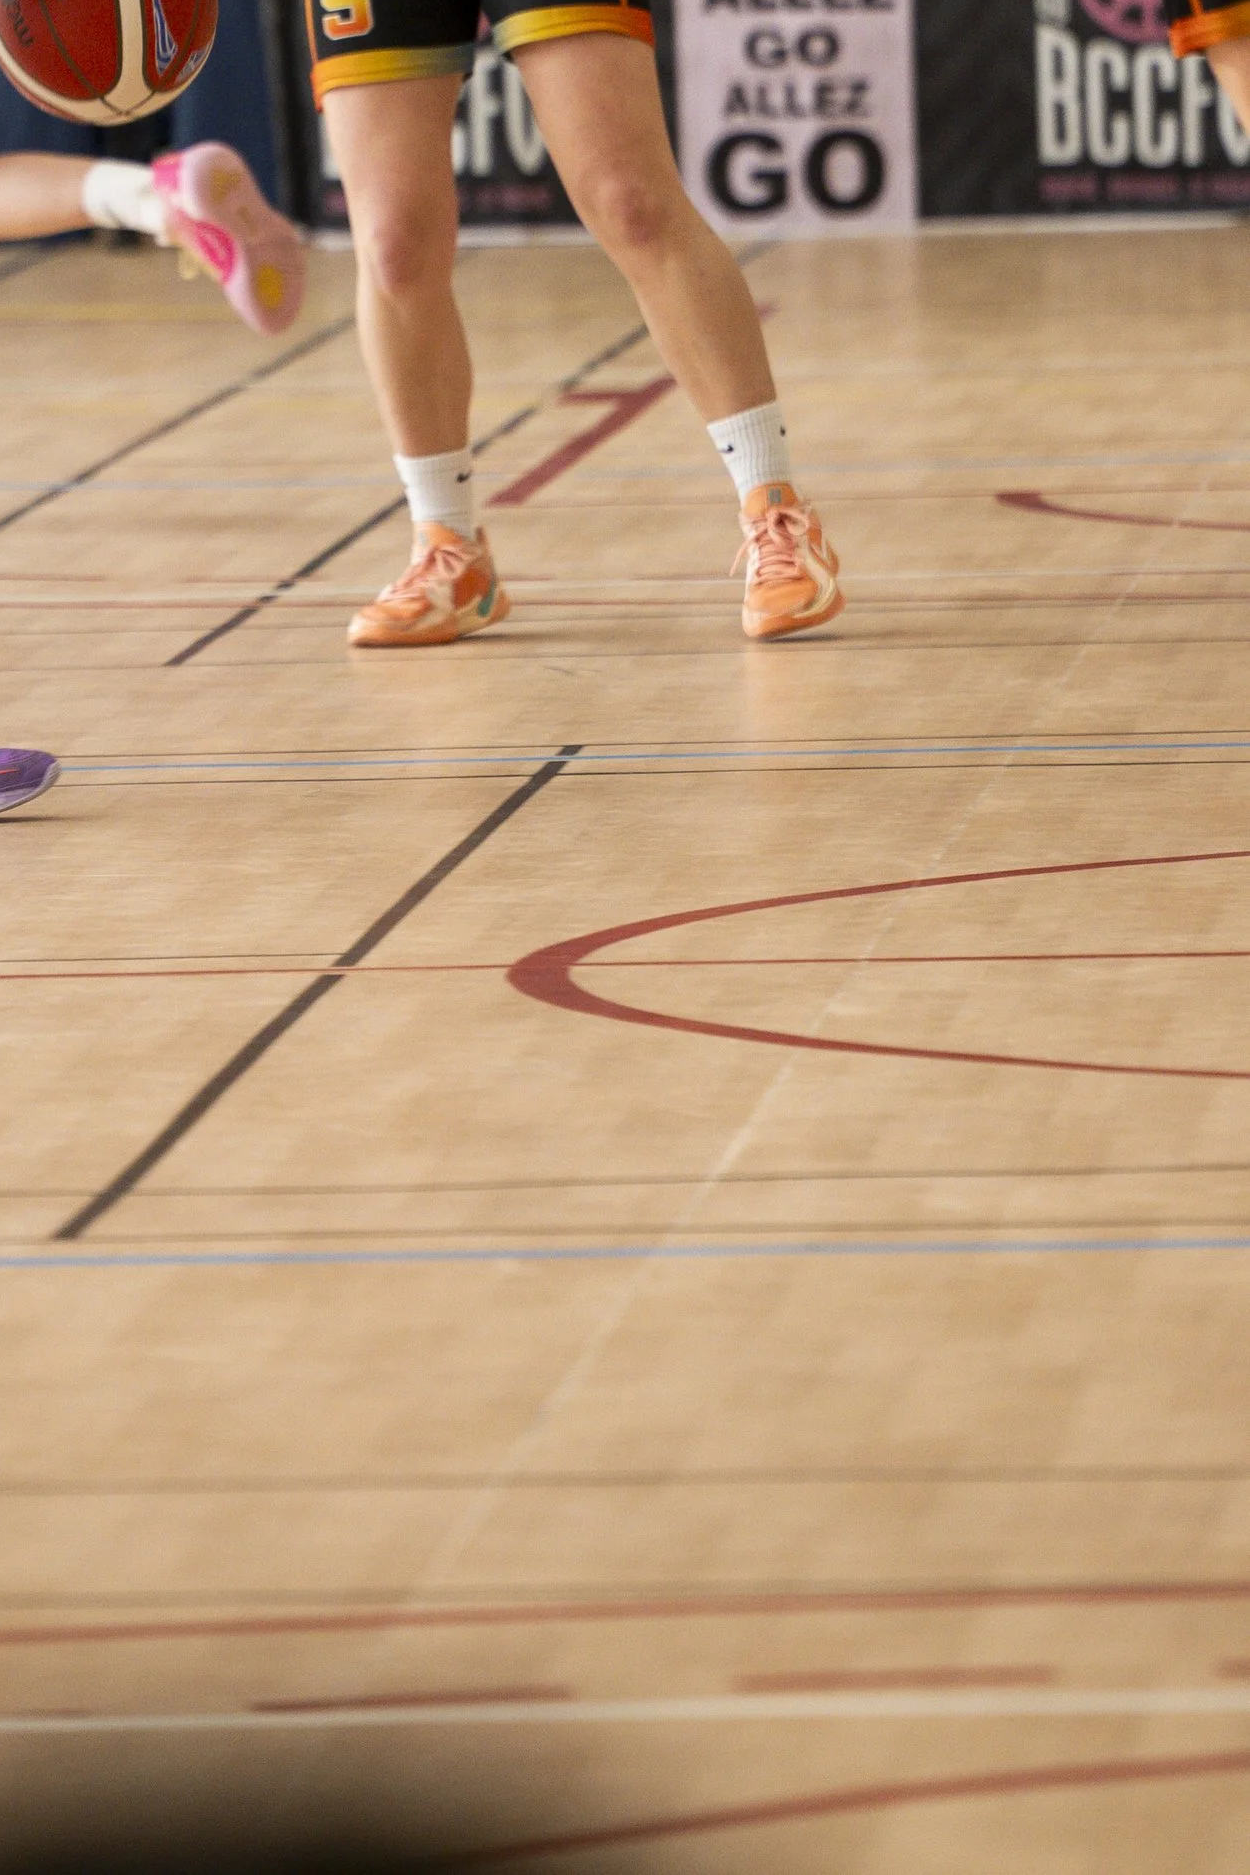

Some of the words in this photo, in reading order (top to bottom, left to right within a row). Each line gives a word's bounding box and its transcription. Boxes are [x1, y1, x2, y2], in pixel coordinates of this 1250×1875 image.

[744, 25, 839, 69] GO
[724, 81, 870, 119] ALLEZ
[707, 131, 884, 216] GO
